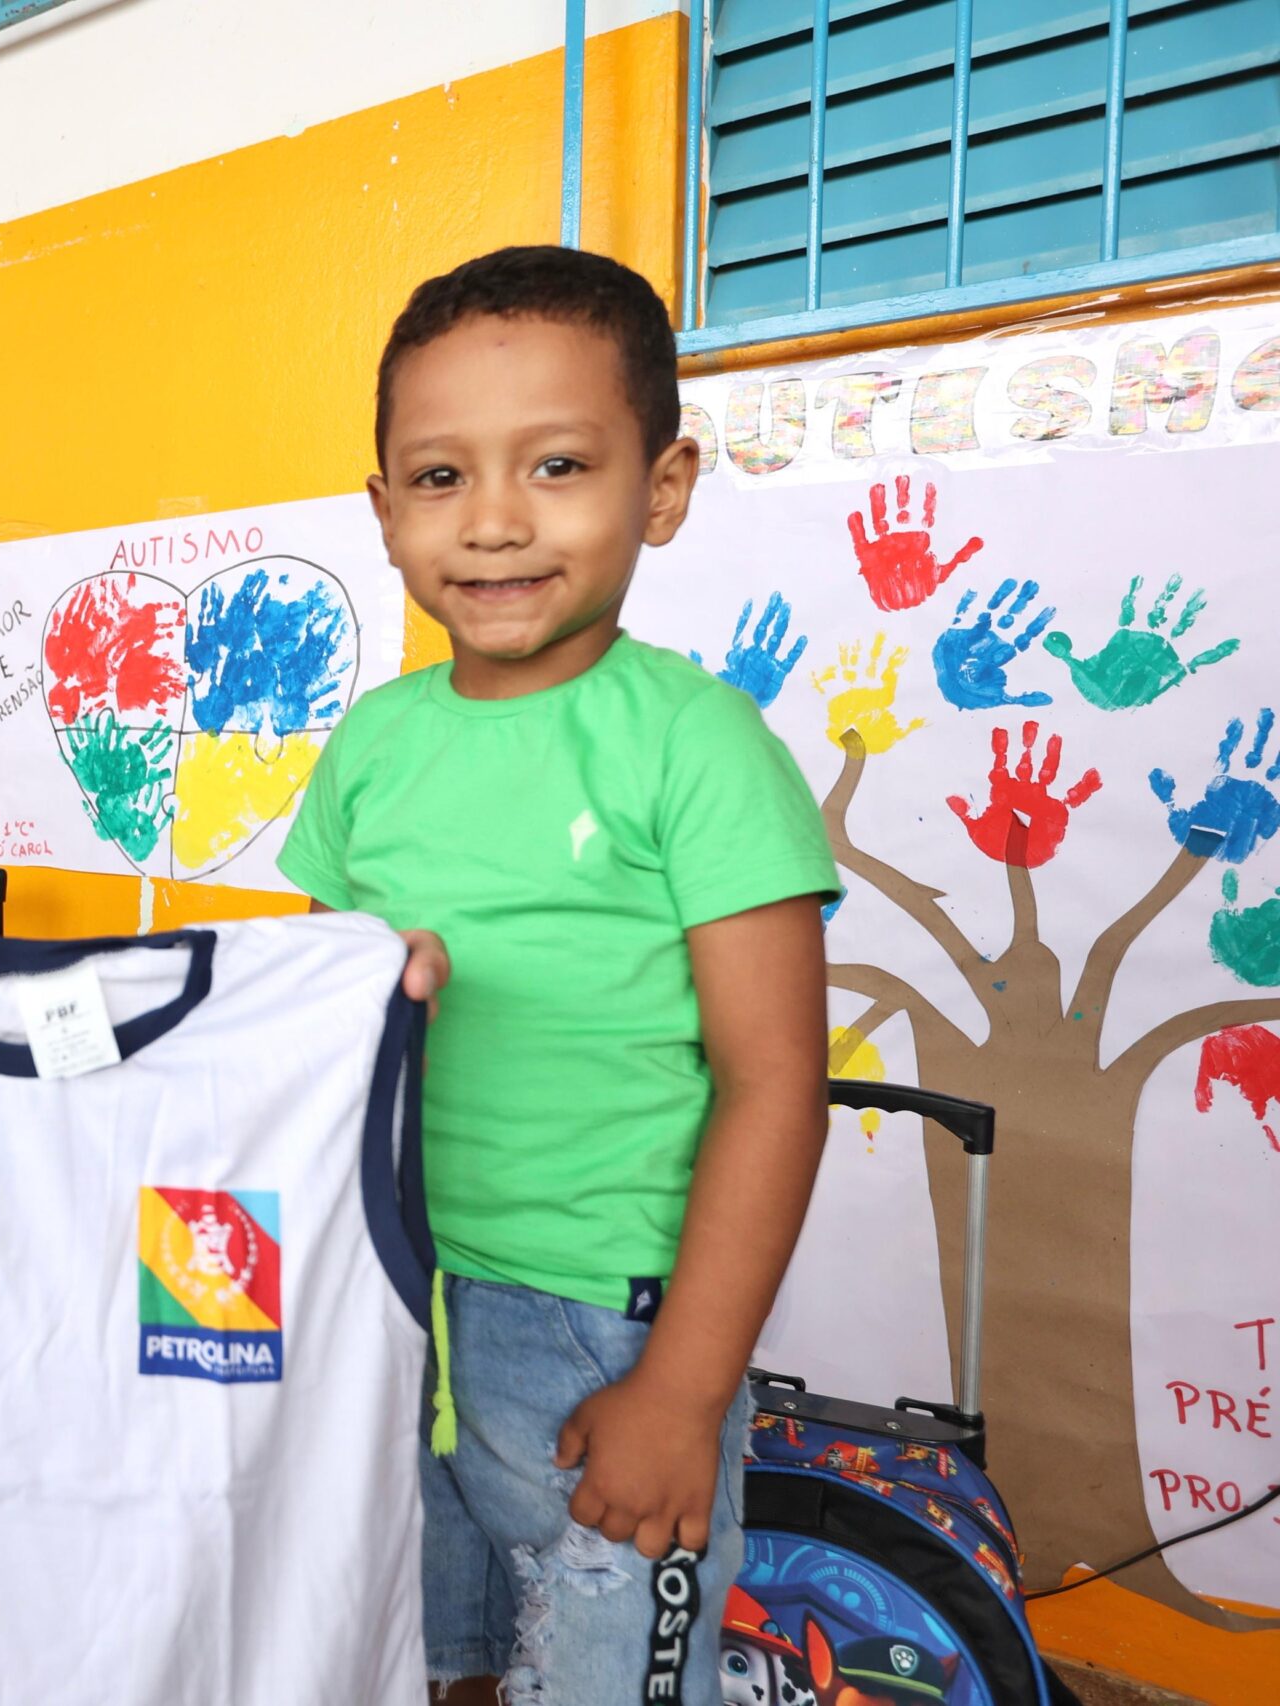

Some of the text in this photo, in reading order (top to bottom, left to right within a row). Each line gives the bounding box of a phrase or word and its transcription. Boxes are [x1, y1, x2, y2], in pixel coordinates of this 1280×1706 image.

[110, 526, 264, 569] AUTISMO
[0, 655, 14, 679] E
[10, 840, 54, 858] CAROL
[146, 1335, 275, 1372] PETROLINA
[1165, 1380, 1272, 1438] PRÉ
